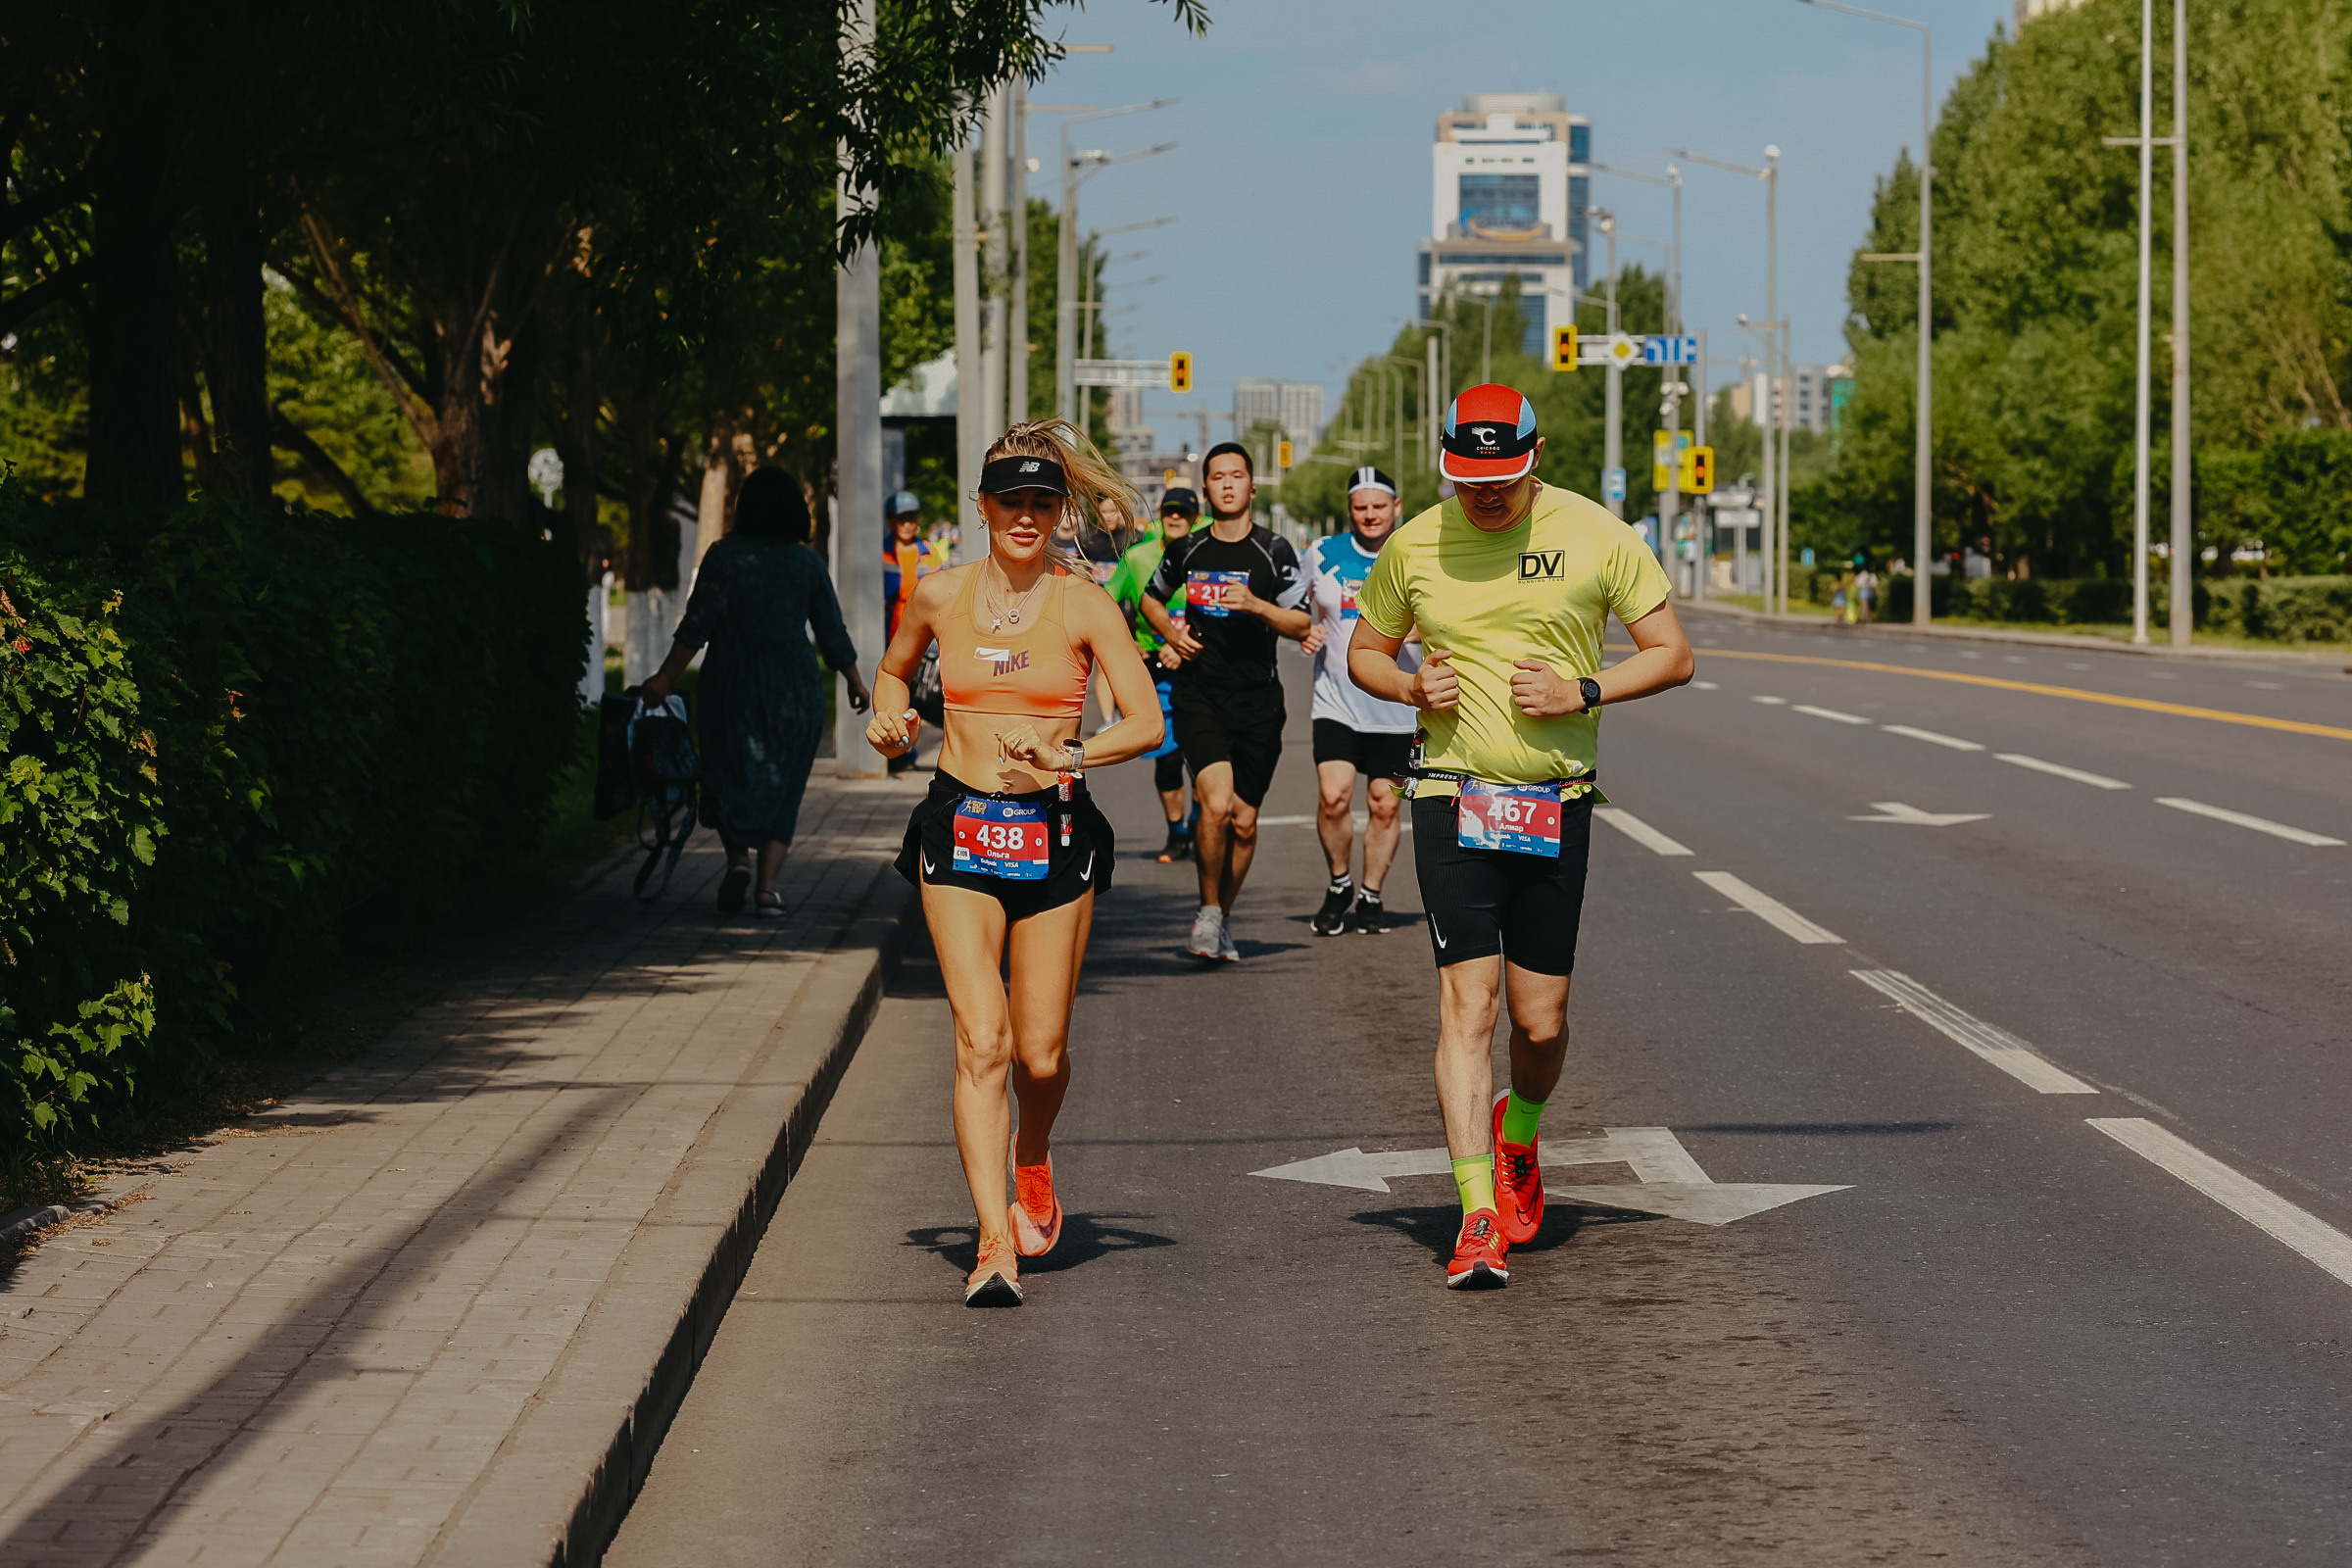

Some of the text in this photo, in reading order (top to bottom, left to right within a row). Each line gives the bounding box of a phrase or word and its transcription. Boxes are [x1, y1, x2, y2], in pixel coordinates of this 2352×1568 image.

[1521, 553, 1562, 578] DV
[993, 649, 1030, 678] NIKE
[1529, 784, 1551, 793] GROUP
[1488, 799, 1537, 824] 467
[976, 824, 1024, 850] 438
[1498, 823, 1524, 834] Алиар
[987, 849, 1010, 858] Ольга
